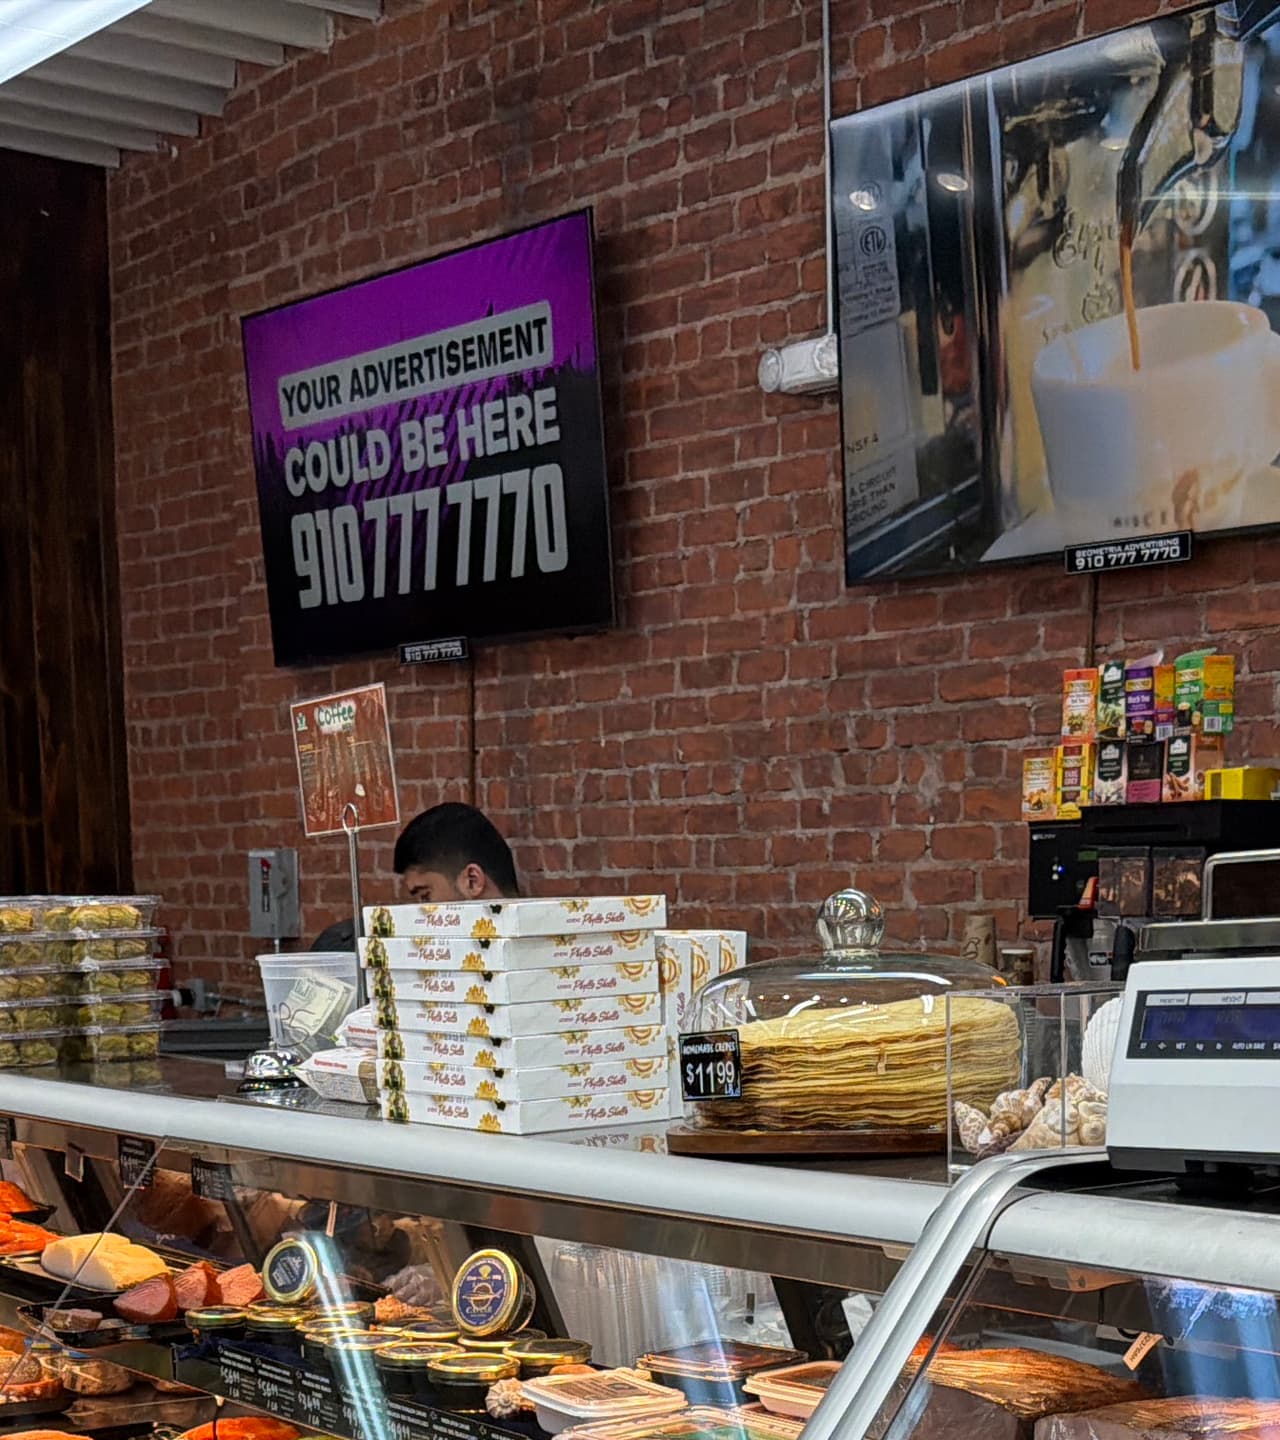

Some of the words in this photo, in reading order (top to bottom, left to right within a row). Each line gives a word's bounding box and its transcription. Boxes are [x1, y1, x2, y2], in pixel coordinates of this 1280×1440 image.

[282, 374, 341, 418] YOUR
[349, 317, 548, 401] ADVERTISEMENT
[284, 429, 391, 497] COULD
[400, 414, 448, 472] BE
[456, 387, 560, 461] HERE
[1076, 546, 1121, 558] GEOMETRIA
[1124, 538, 1179, 551] ADVERTISING
[1076, 556, 1104, 570] 910
[1108, 551, 1136, 565] 777
[1141, 546, 1179, 561] 7770
[405, 651, 421, 662] 910
[423, 649, 439, 660] 777
[441, 647, 462, 658] 7770
[686, 1061, 734, 1094] $1199
